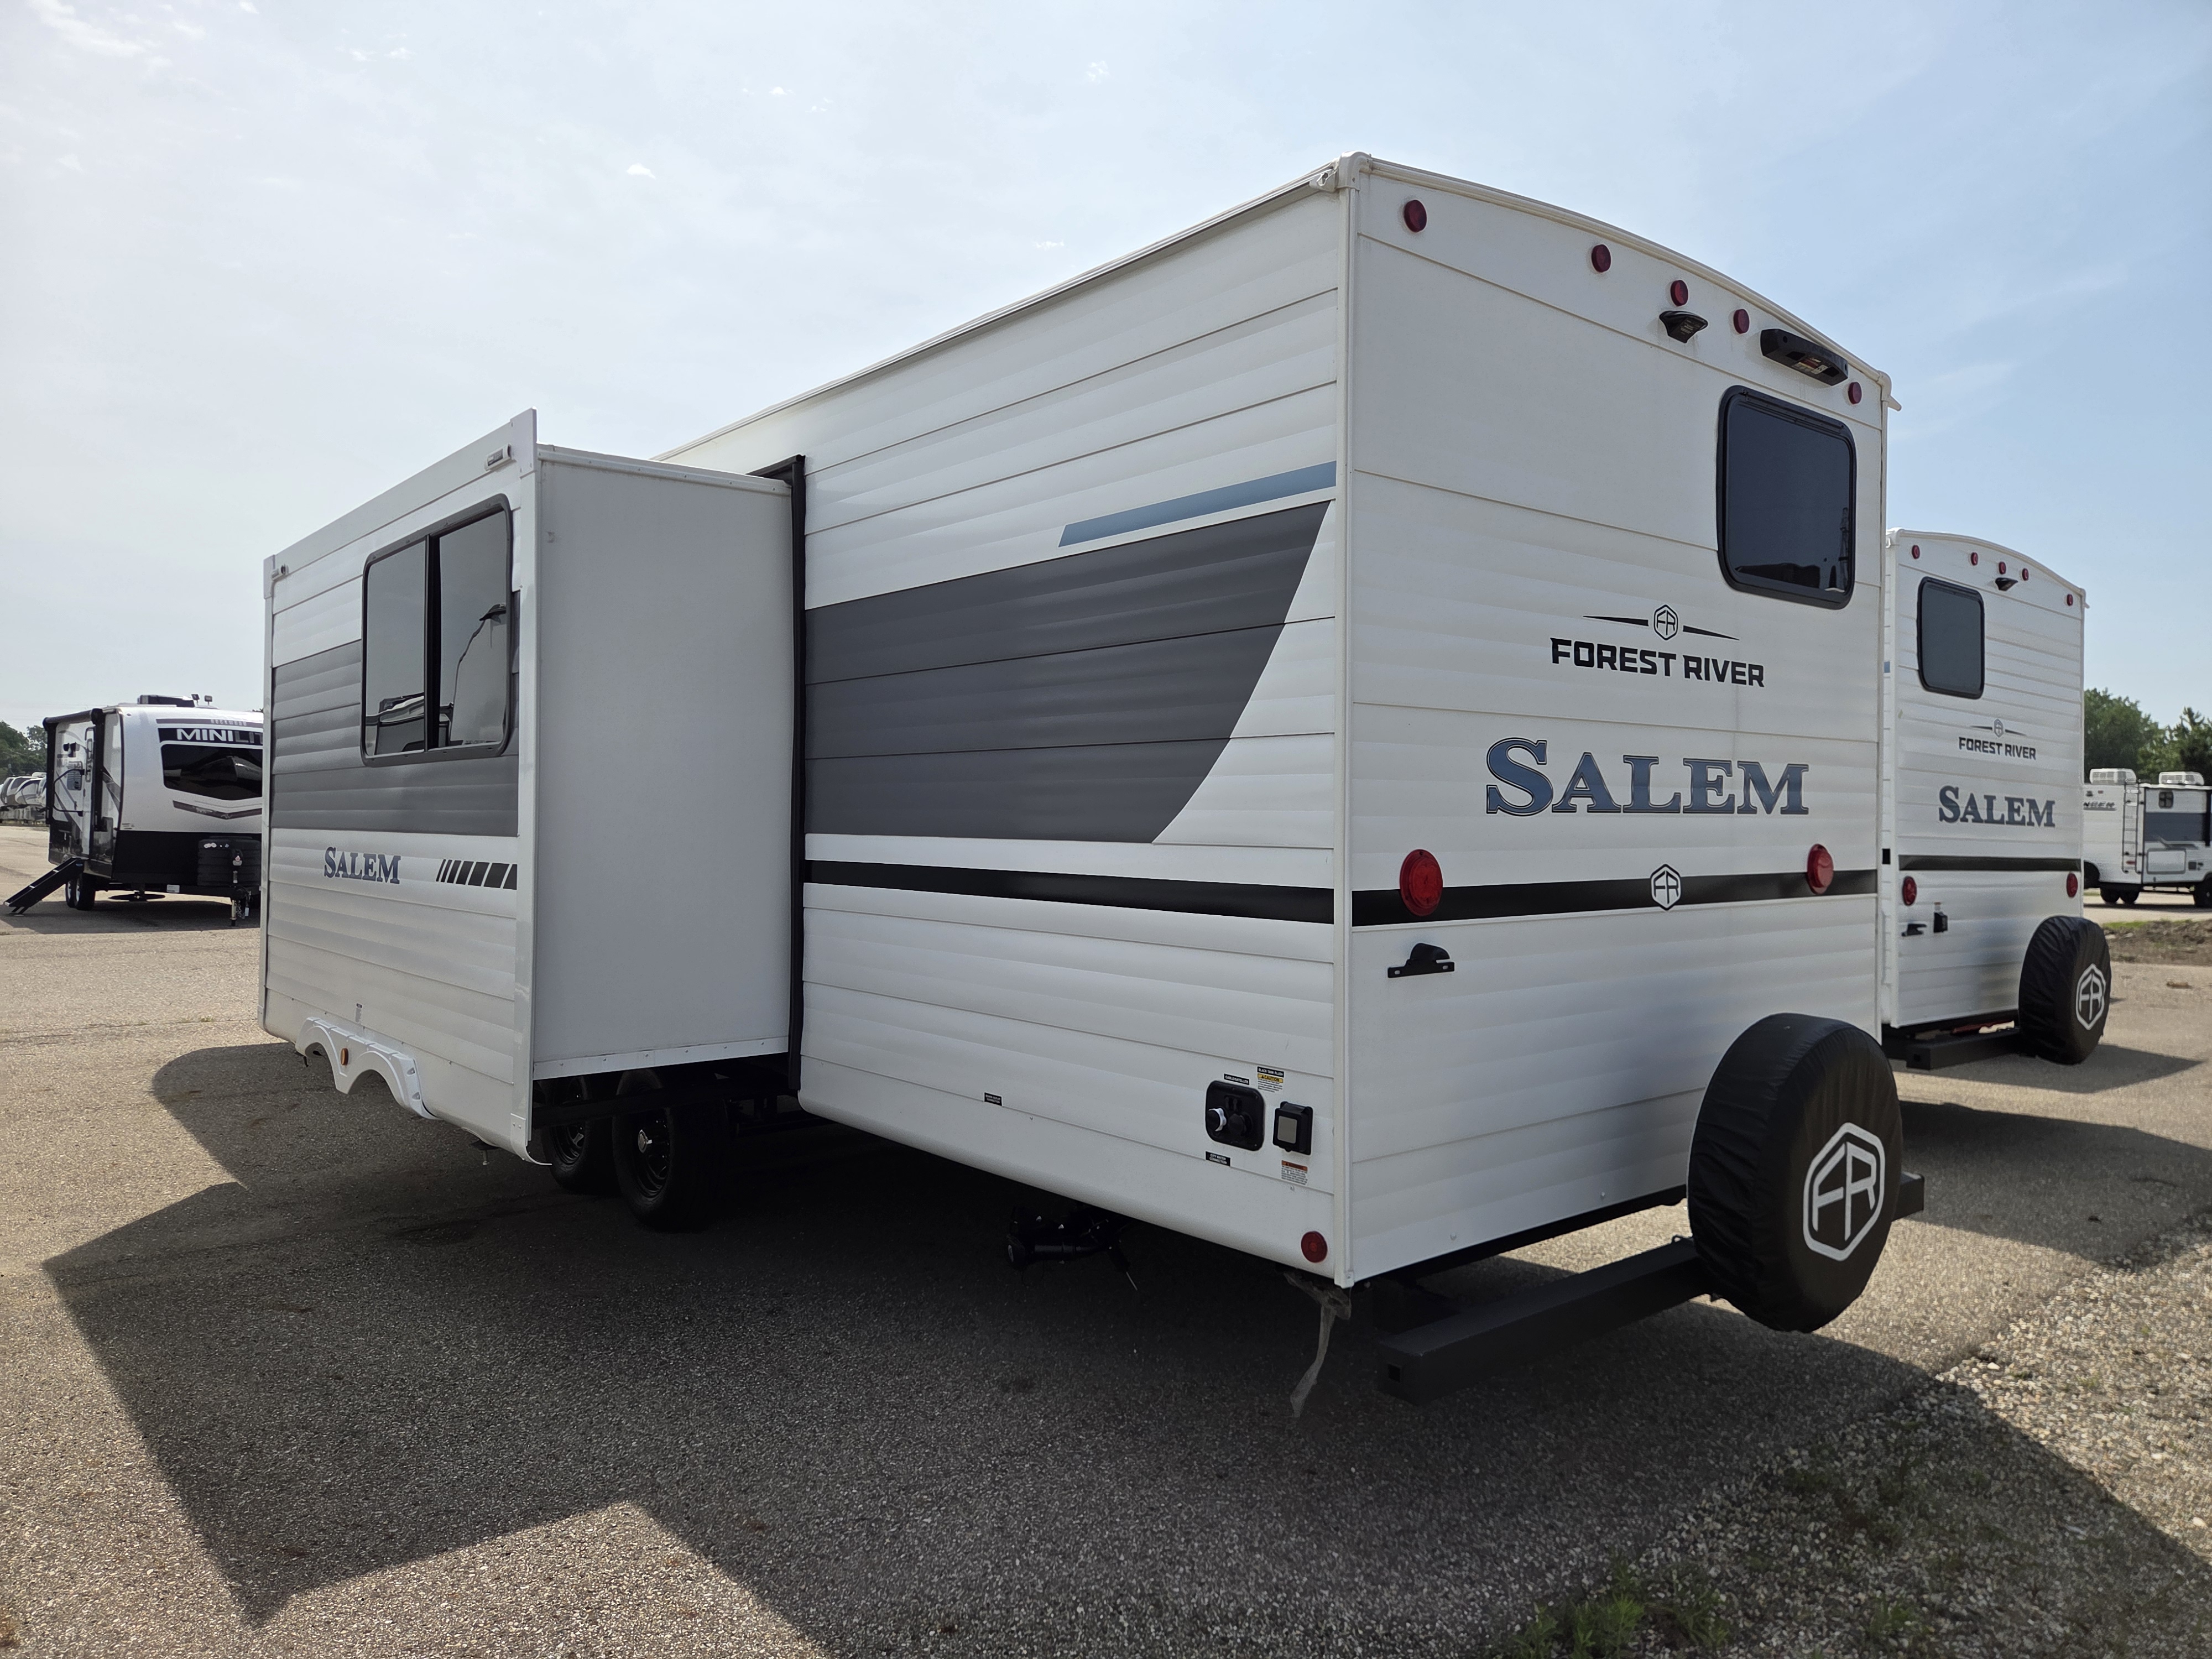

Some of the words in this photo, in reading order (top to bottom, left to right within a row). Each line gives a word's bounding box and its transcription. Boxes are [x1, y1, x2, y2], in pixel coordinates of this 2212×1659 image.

[1550, 637, 1677, 677] FOREST
[1682, 655, 1765, 688] RIVER
[1958, 737, 2002, 755] FOREST
[2005, 744, 2037, 760] RIVER
[1486, 737, 1809, 817] SALEM
[1938, 785, 2056, 828] SALEM
[324, 846, 401, 885] SALEM
